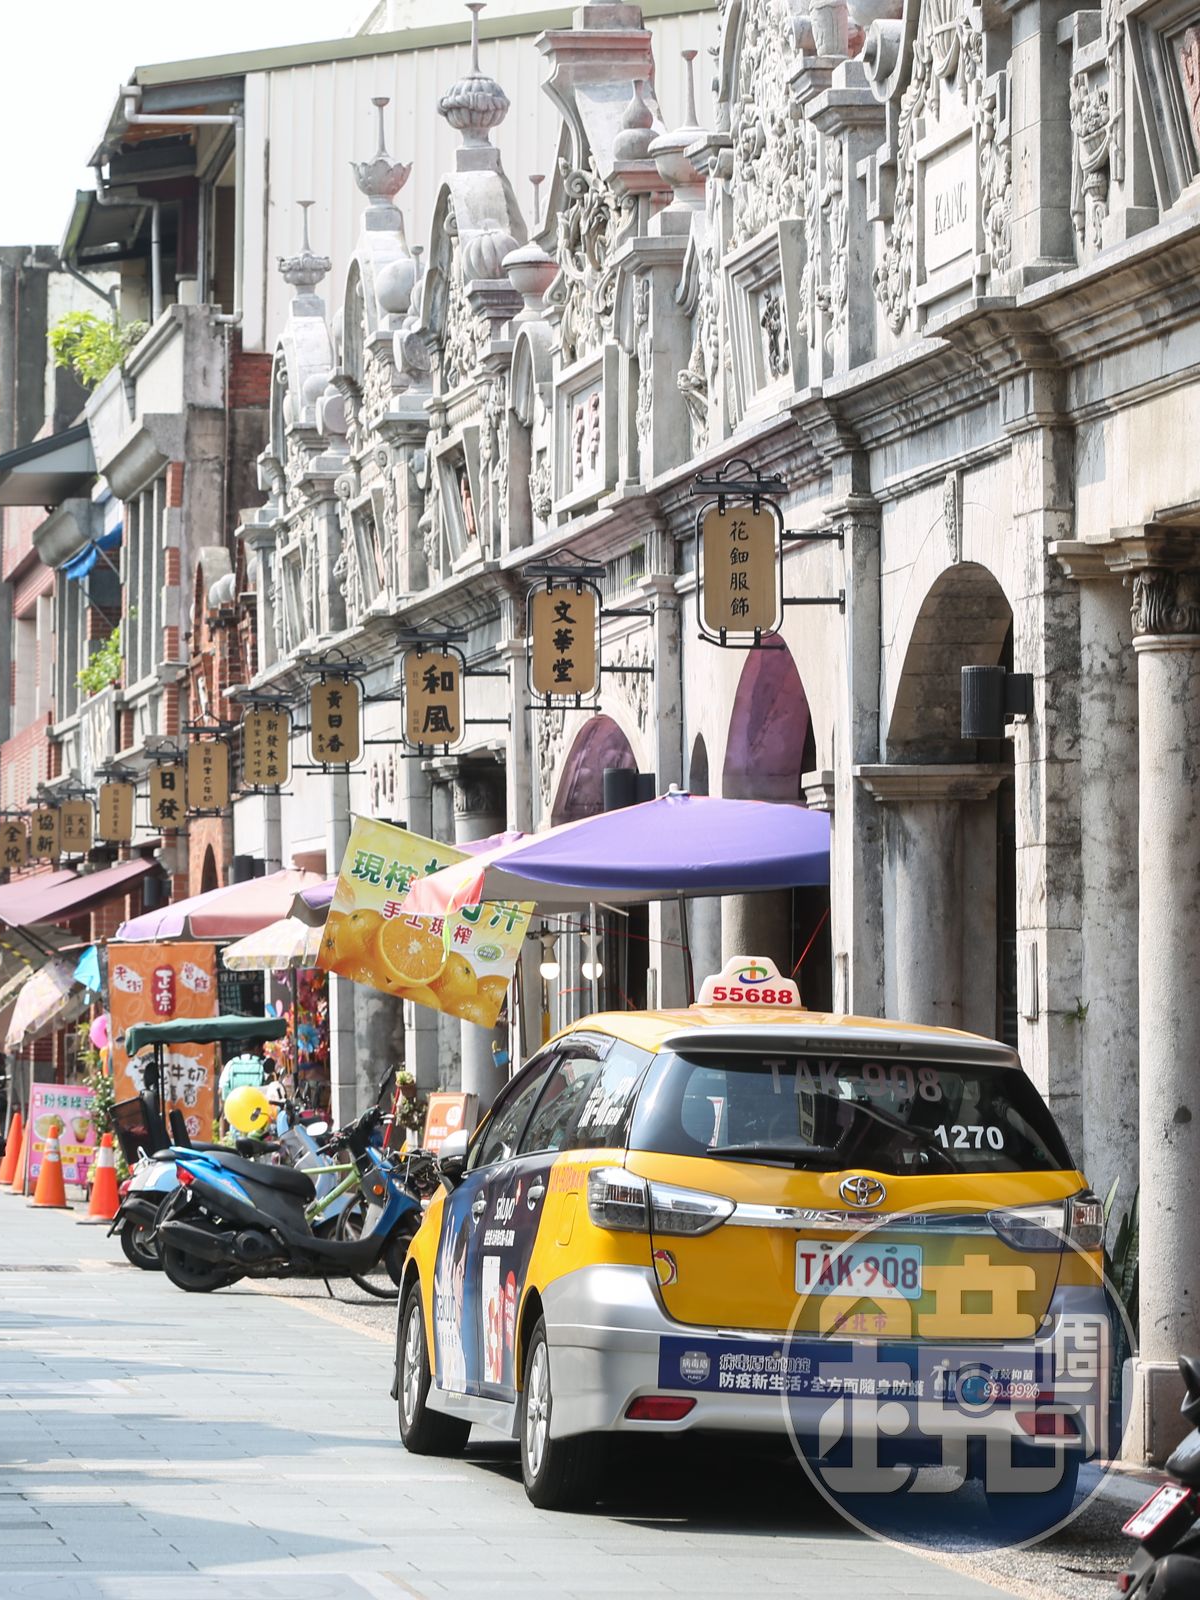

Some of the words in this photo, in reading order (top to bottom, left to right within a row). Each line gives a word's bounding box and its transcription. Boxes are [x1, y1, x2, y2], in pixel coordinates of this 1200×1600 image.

[729, 520, 750, 618] 花鈿服飾
[552, 600, 577, 684] 文華堂
[422, 664, 455, 734] 和風
[156, 771, 180, 821] 日發
[36, 814, 54, 852] 協新
[351, 850, 524, 933] 現榨汁
[155, 969, 173, 1012] 正宗
[712, 987, 793, 1005] 55688
[933, 1124, 1005, 1150] 1270
[983, 1381, 1040, 1399] 99.99%
